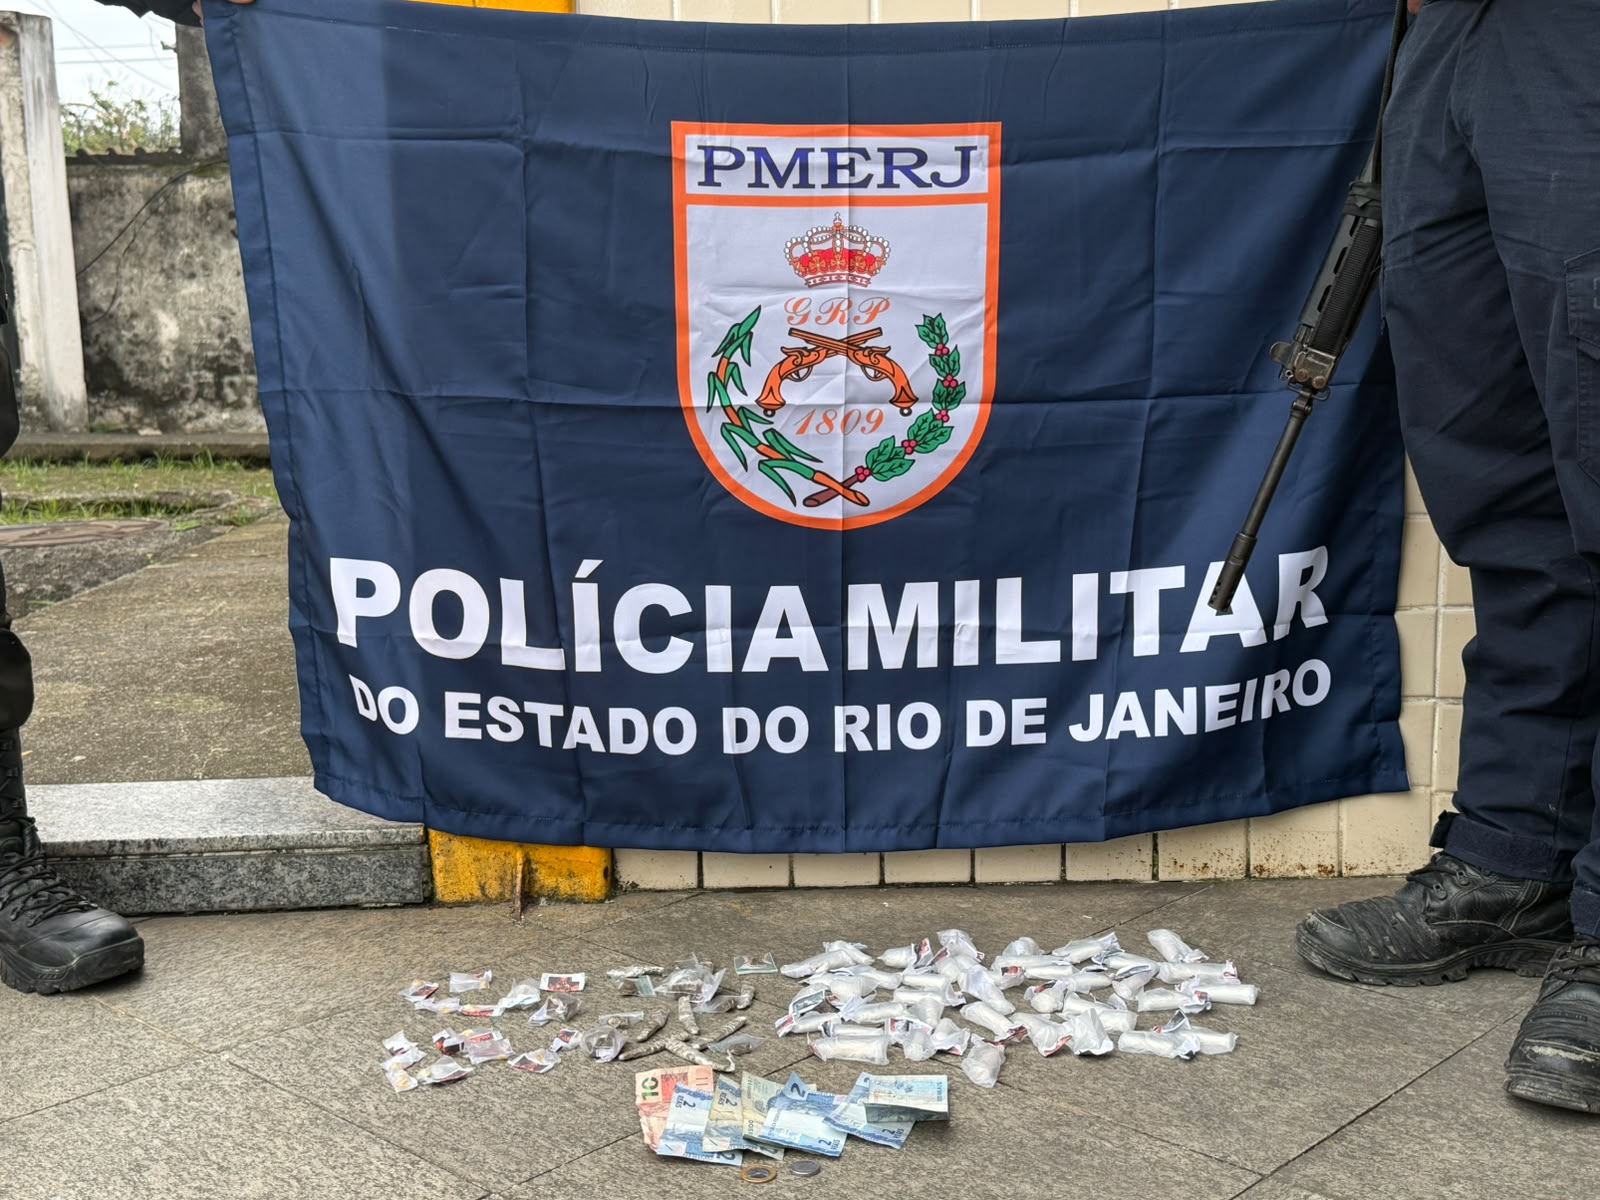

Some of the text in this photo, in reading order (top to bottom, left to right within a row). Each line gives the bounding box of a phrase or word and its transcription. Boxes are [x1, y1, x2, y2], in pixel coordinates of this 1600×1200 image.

[697, 144, 978, 190] PMERJ
[795, 407, 885, 437] 1809
[330, 546, 1329, 675] POLÍCIA MILITAR
[349, 658, 1332, 755] DO ESTADO DO RIO DE JANEIRO
[641, 1076, 660, 1100] 10
[790, 1082, 806, 1098] 2
